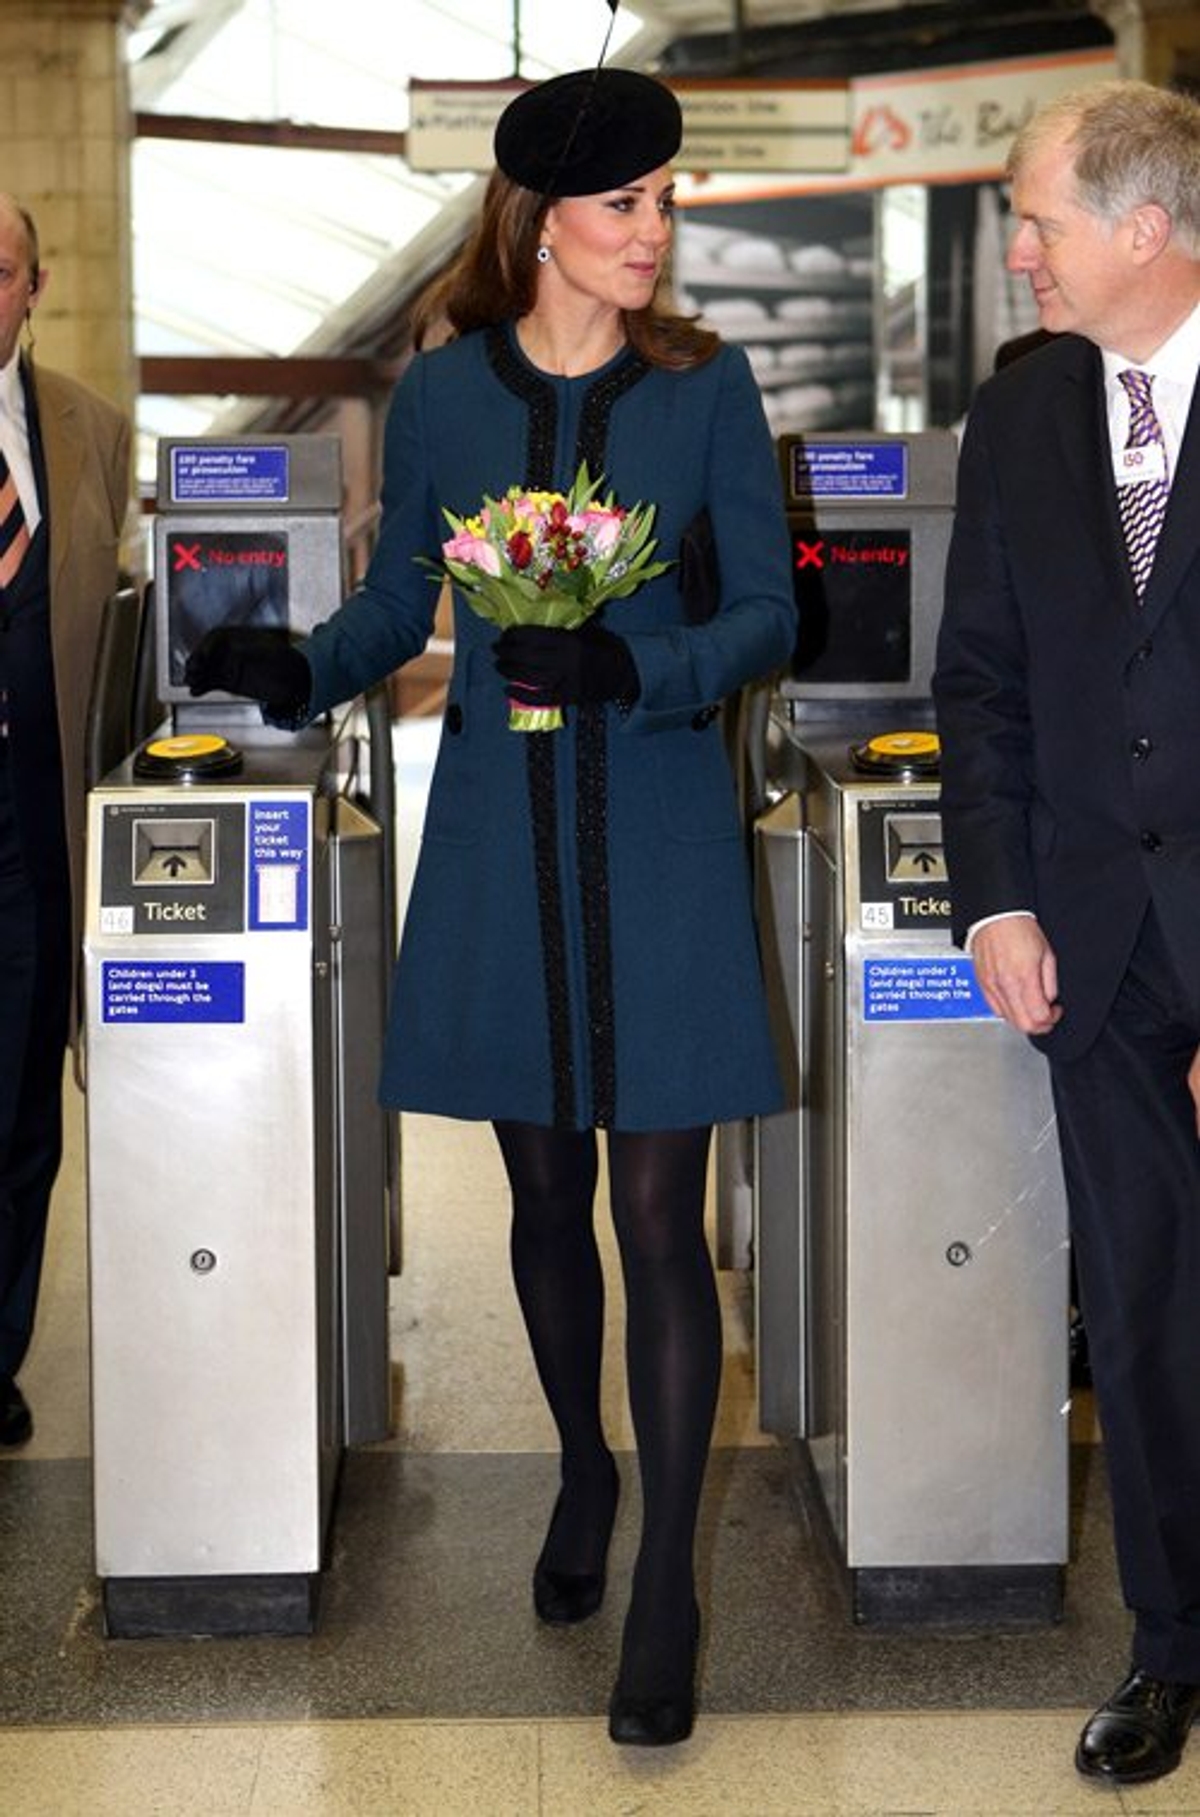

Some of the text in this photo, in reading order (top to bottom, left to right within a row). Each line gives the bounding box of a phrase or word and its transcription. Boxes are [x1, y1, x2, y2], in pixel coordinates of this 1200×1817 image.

[199, 454, 233, 467] penalty
[235, 453, 256, 464] fare
[818, 451, 853, 463] penalty
[854, 450, 875, 461] fare
[191, 465, 249, 476] prosecution
[810, 463, 867, 472] prosecution
[207, 550, 285, 567] No entry
[830, 546, 909, 566] No entry
[254, 823, 280, 834] your
[254, 835, 289, 846] ticket
[254, 848, 303, 861] this way
[144, 902, 206, 921] Ticket
[899, 897, 951, 916] Ticke
[103, 912, 130, 928] 46
[864, 908, 890, 925] 45
[108, 969, 153, 979] Children
[156, 970, 187, 979] under
[869, 965, 957, 976] Children under 5
[108, 980, 209, 992] (and dogs) must be
[869, 977, 969, 990] (and dogs) must be
[108, 993, 212, 1005] carried through the
[869, 989, 971, 1002] carried through the
[108, 1005, 139, 1016] gates
[870, 1002, 899, 1014] gates
